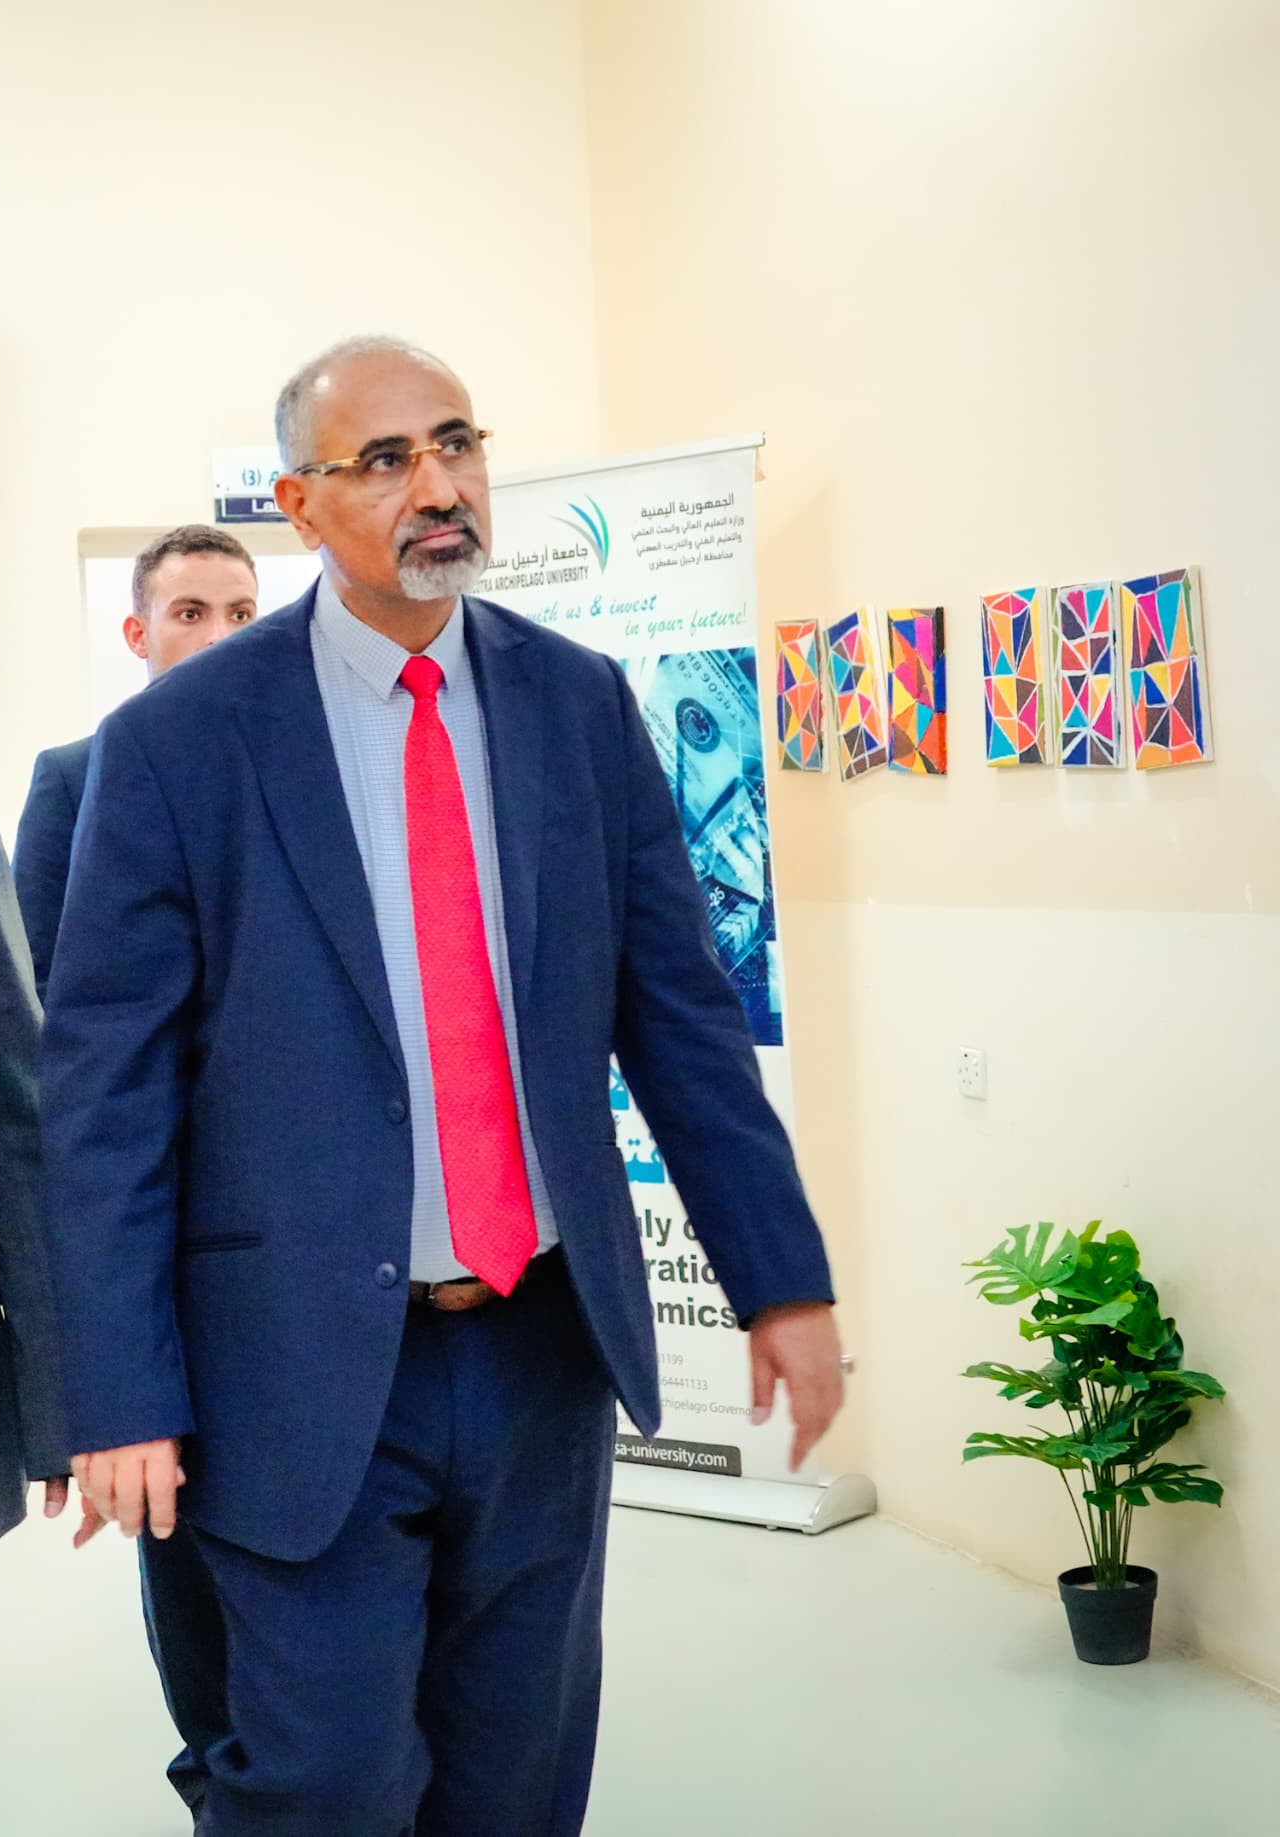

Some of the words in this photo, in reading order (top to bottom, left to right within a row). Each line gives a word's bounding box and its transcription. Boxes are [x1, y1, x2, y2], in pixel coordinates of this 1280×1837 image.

[241, 466, 262, 487] (3)
[251, 498, 282, 514] La
[640, 500, 676, 520] اليمنية
[678, 490, 735, 516] الجمهورية
[511, 543, 549, 571] أرخبيل
[552, 543, 589, 560] جامعة
[494, 571, 545, 591] ARCHIPELAGO
[546, 565, 589, 585] UNIVERSITY
[565, 609, 582, 620] us
[589, 594, 602, 617] &
[609, 594, 657, 615] invest
[624, 619, 640, 637] in
[647, 617, 684, 640] your
[644, 1253, 719, 1285] ratio
[655, 1296, 738, 1329] mics
[709, 1401, 752, 1416] Governo
